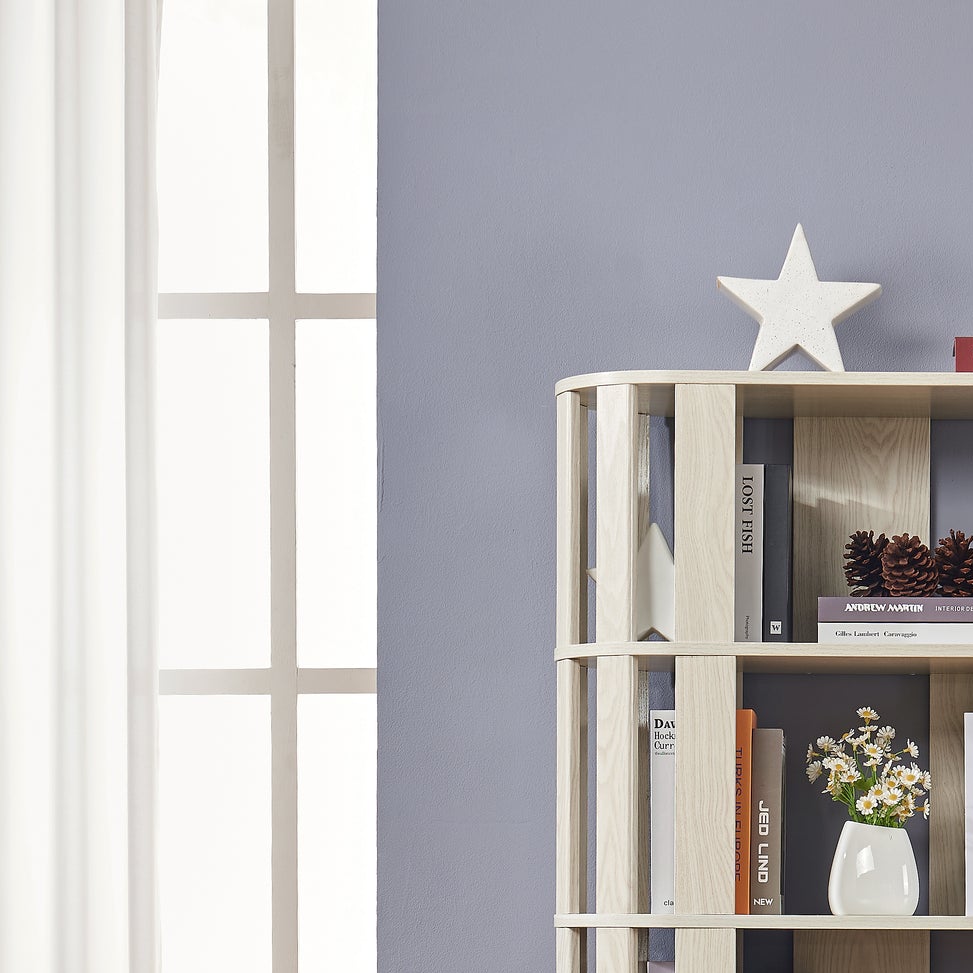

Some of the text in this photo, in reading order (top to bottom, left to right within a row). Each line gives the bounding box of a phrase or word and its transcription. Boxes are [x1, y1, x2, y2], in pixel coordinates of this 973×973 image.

[742, 476, 754, 554] LOST FISH
[844, 603, 924, 613] ANDREW MARTIN
[884, 630, 918, 639] Caravaggio
[758, 800, 770, 884] JED LIND
[753, 898, 774, 906] NEW
